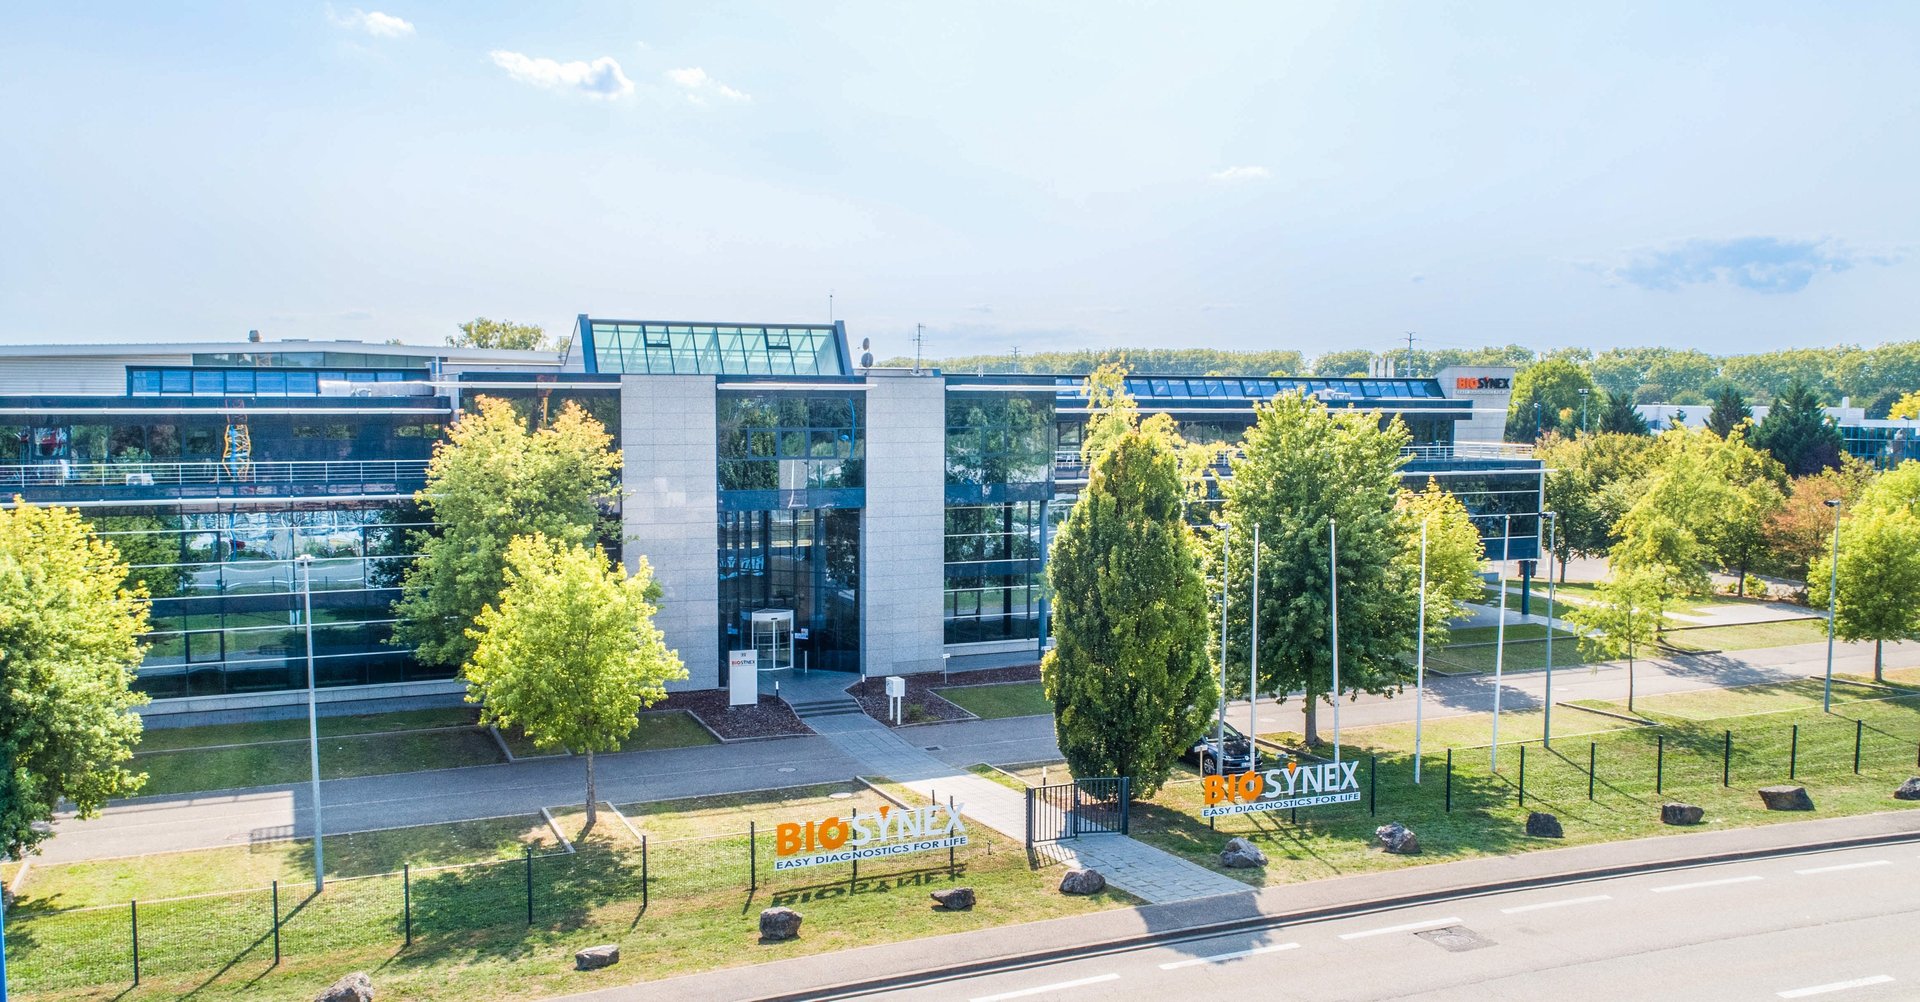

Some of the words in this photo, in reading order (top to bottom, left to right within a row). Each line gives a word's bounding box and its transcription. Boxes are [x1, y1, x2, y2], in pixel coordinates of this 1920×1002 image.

[1456, 376, 1510, 390] BIOSYNEX
[1204, 760, 1360, 805] BIOSYNEX
[1203, 807, 1231, 817] EASY
[1235, 798, 1312, 813] DIAGNOSTICS
[1315, 796, 1337, 804] FOR
[1340, 793, 1360, 801] LIFE
[776, 802, 966, 857] BIOSYNEX
[776, 857, 811, 870] EASY
[816, 844, 910, 864] DIAGNOSTICS
[914, 841, 939, 851] FOR
[943, 836, 967, 847] LIFE
